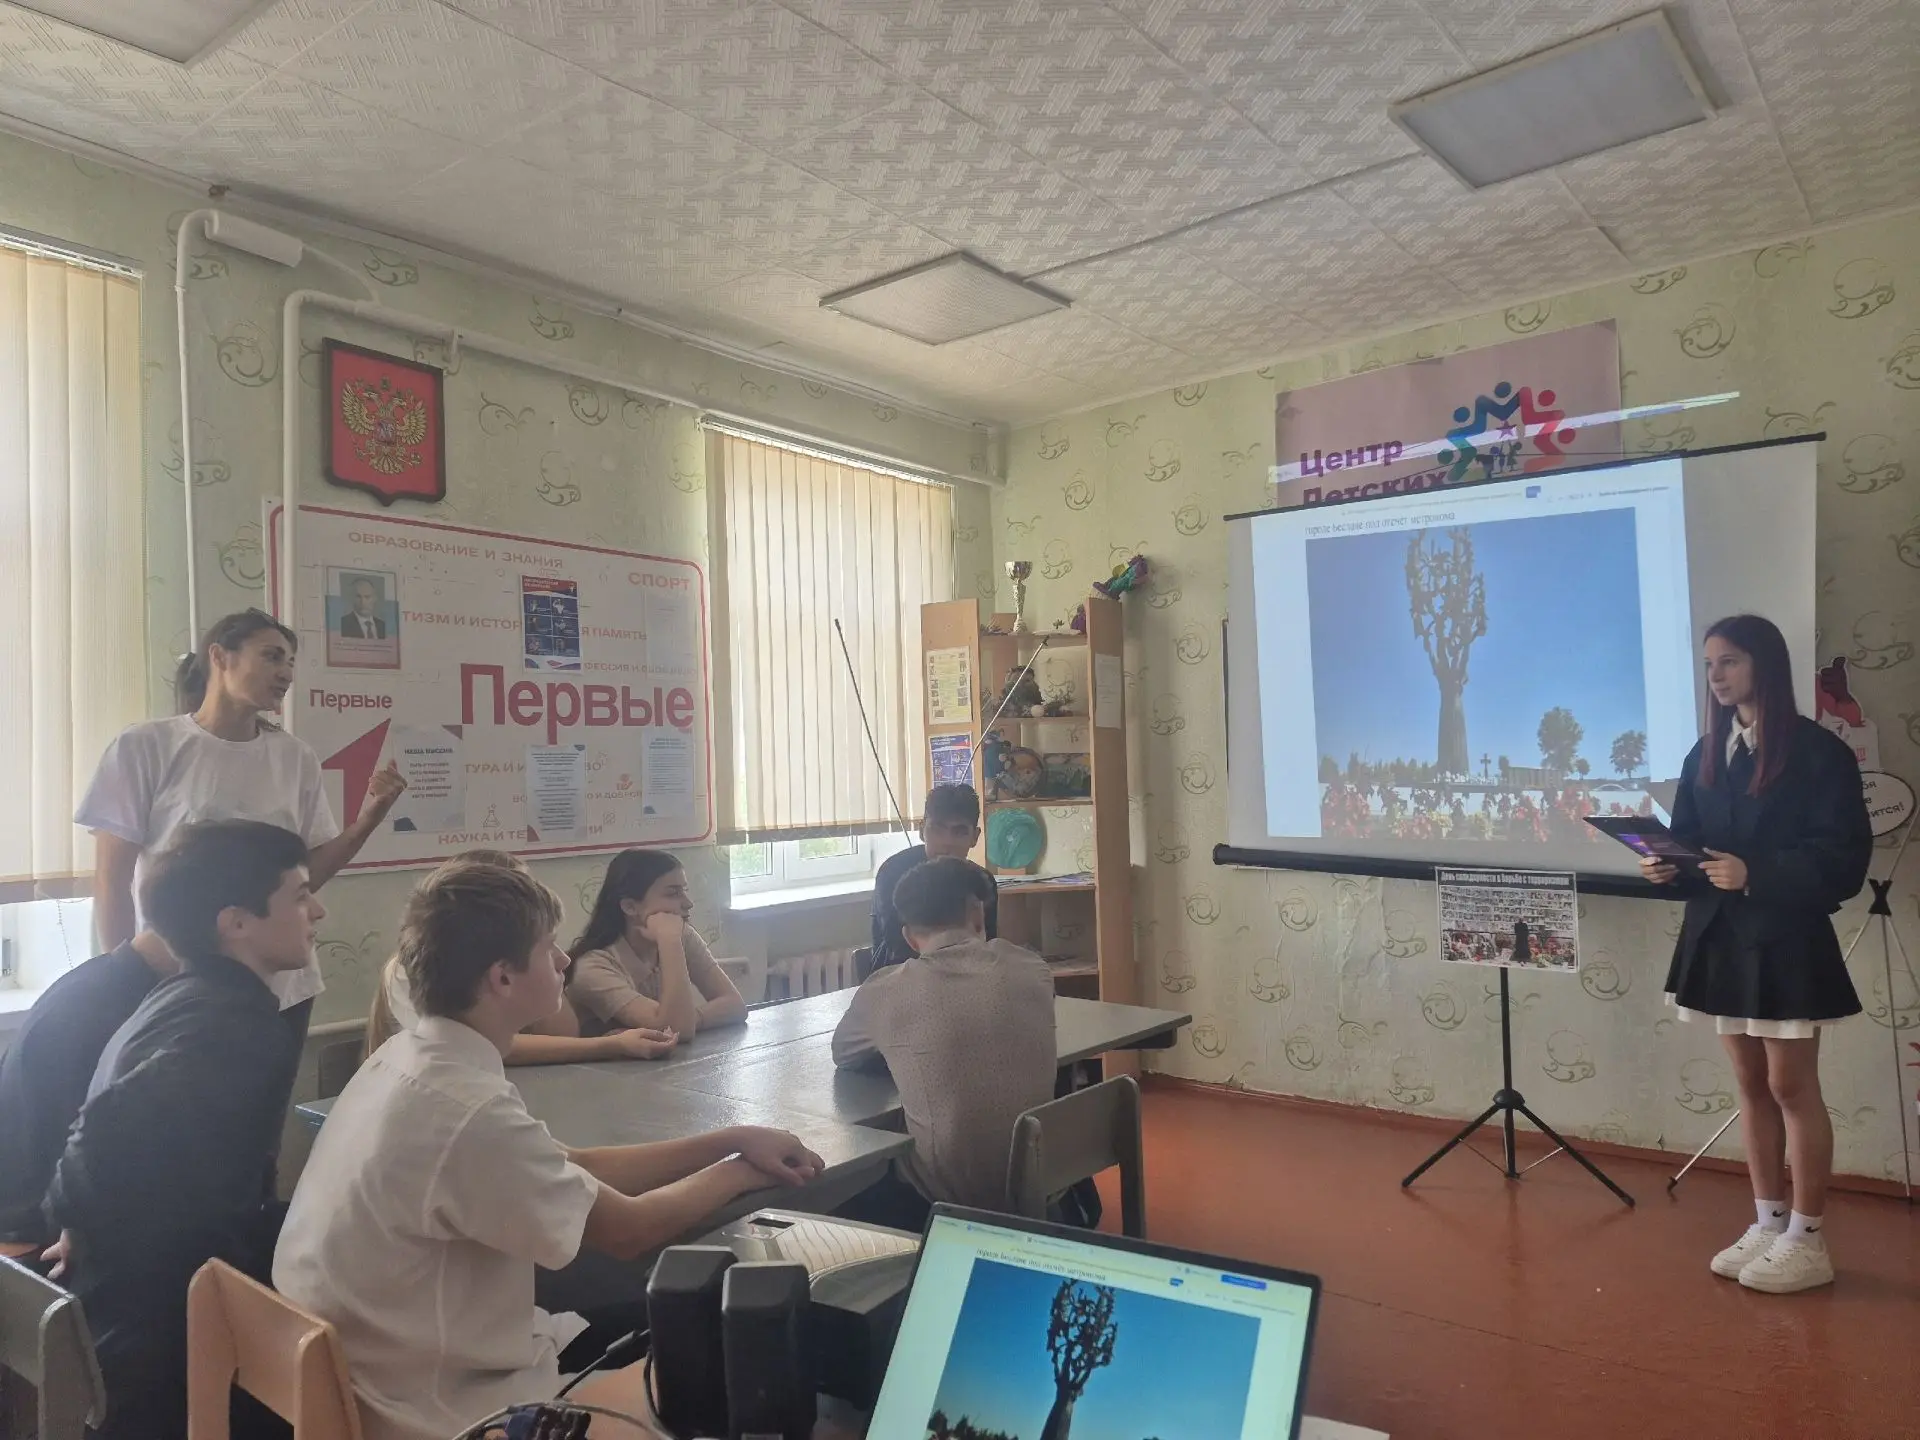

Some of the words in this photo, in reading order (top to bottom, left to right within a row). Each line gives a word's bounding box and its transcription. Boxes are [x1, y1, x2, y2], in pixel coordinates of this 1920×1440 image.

[1301, 440, 1403, 477] Центр
[348, 531, 479, 558] ОБРАЗОВАНИЕ
[485, 551, 496, 560] И
[502, 552, 563, 568] ЗНАНИЯ
[628, 572, 691, 590] СПОРТ
[402, 610, 449, 625] ТИЗМ
[454, 614, 465, 625] И
[593, 627, 648, 640] ПАМЯТЬ
[584, 661, 629, 672] ФЕССИЯ
[310, 689, 393, 713] Первые
[461, 663, 694, 746] Первые
[465, 763, 500, 774] ТУРА
[439, 831, 491, 845] НАУКА
[494, 831, 504, 840] И
